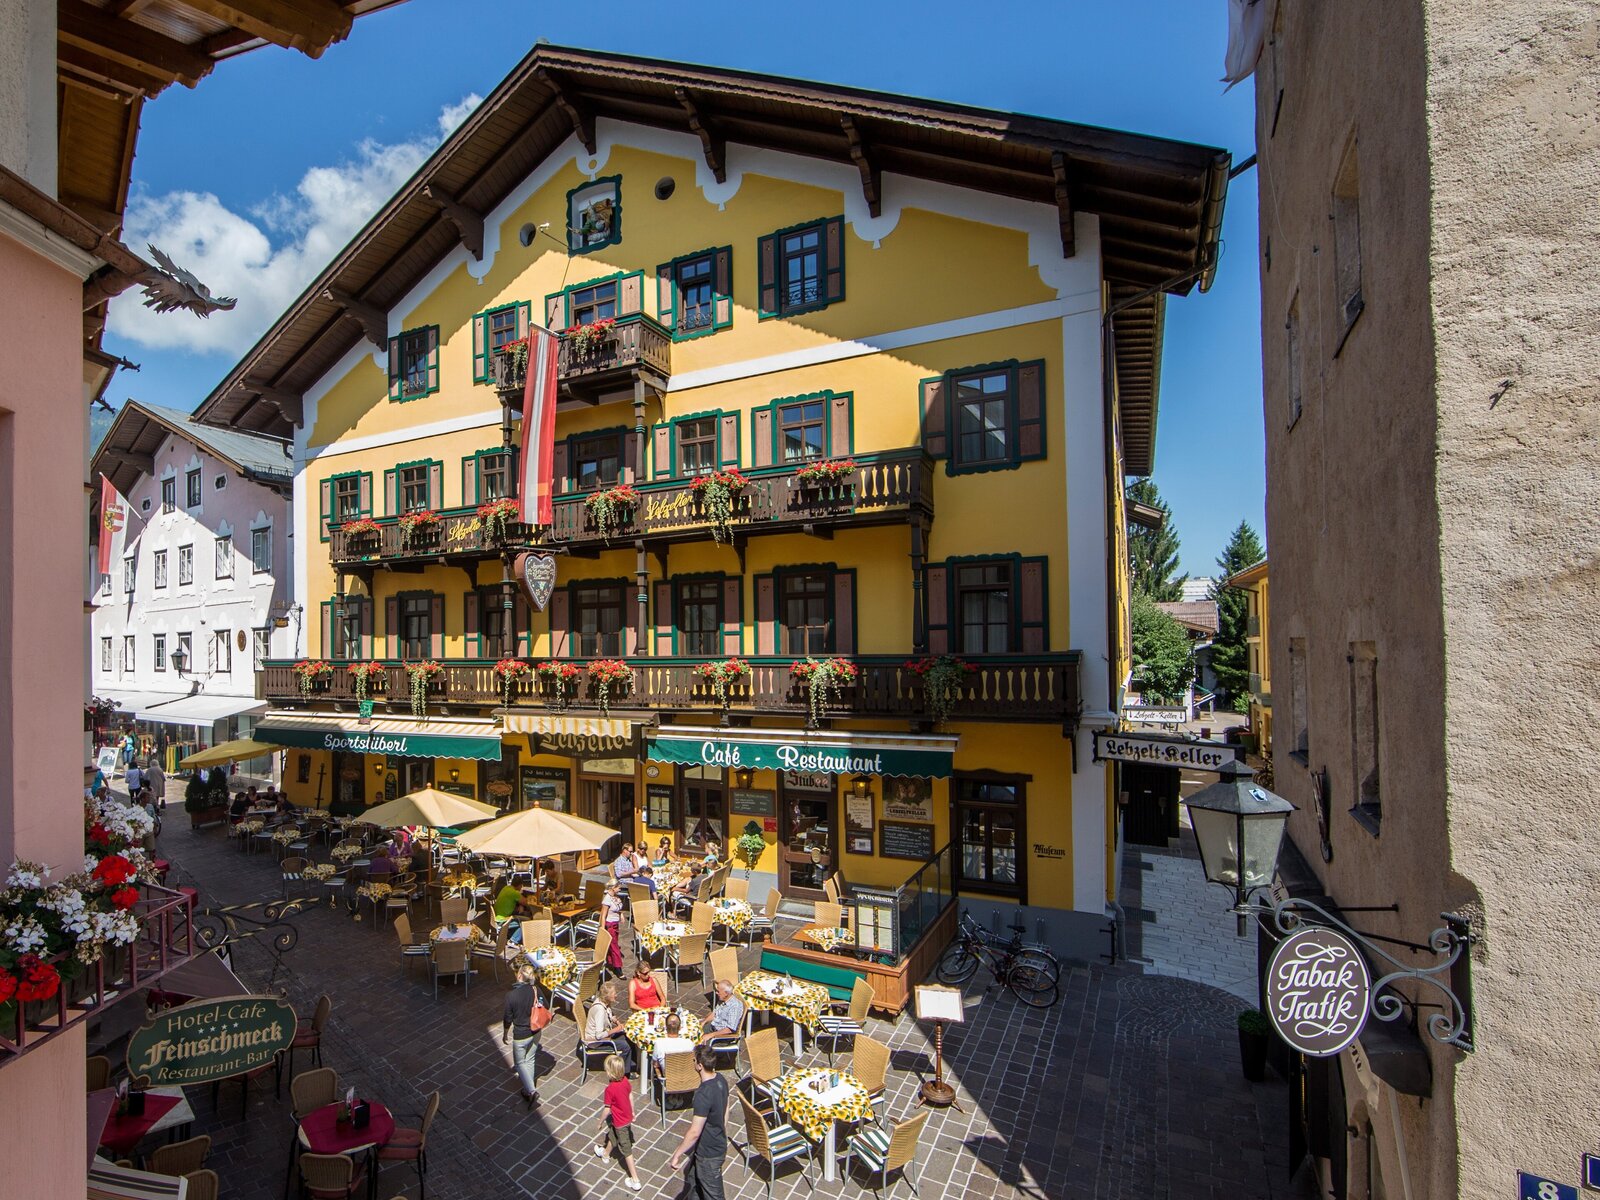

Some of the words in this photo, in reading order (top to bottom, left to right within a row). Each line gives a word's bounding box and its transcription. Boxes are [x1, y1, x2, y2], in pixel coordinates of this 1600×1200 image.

[324, 733, 408, 752] Sportstüberl
[701, 741, 741, 765] Café
[776, 745, 883, 772] Restaurant
[1277, 958, 1359, 991] Tabak
[1277, 990, 1358, 1023] Trafik
[139, 1020, 283, 1071] Feinschmeck
[157, 1048, 270, 1080] Restaurant-Bar
[1538, 1181, 1560, 1200] 8
